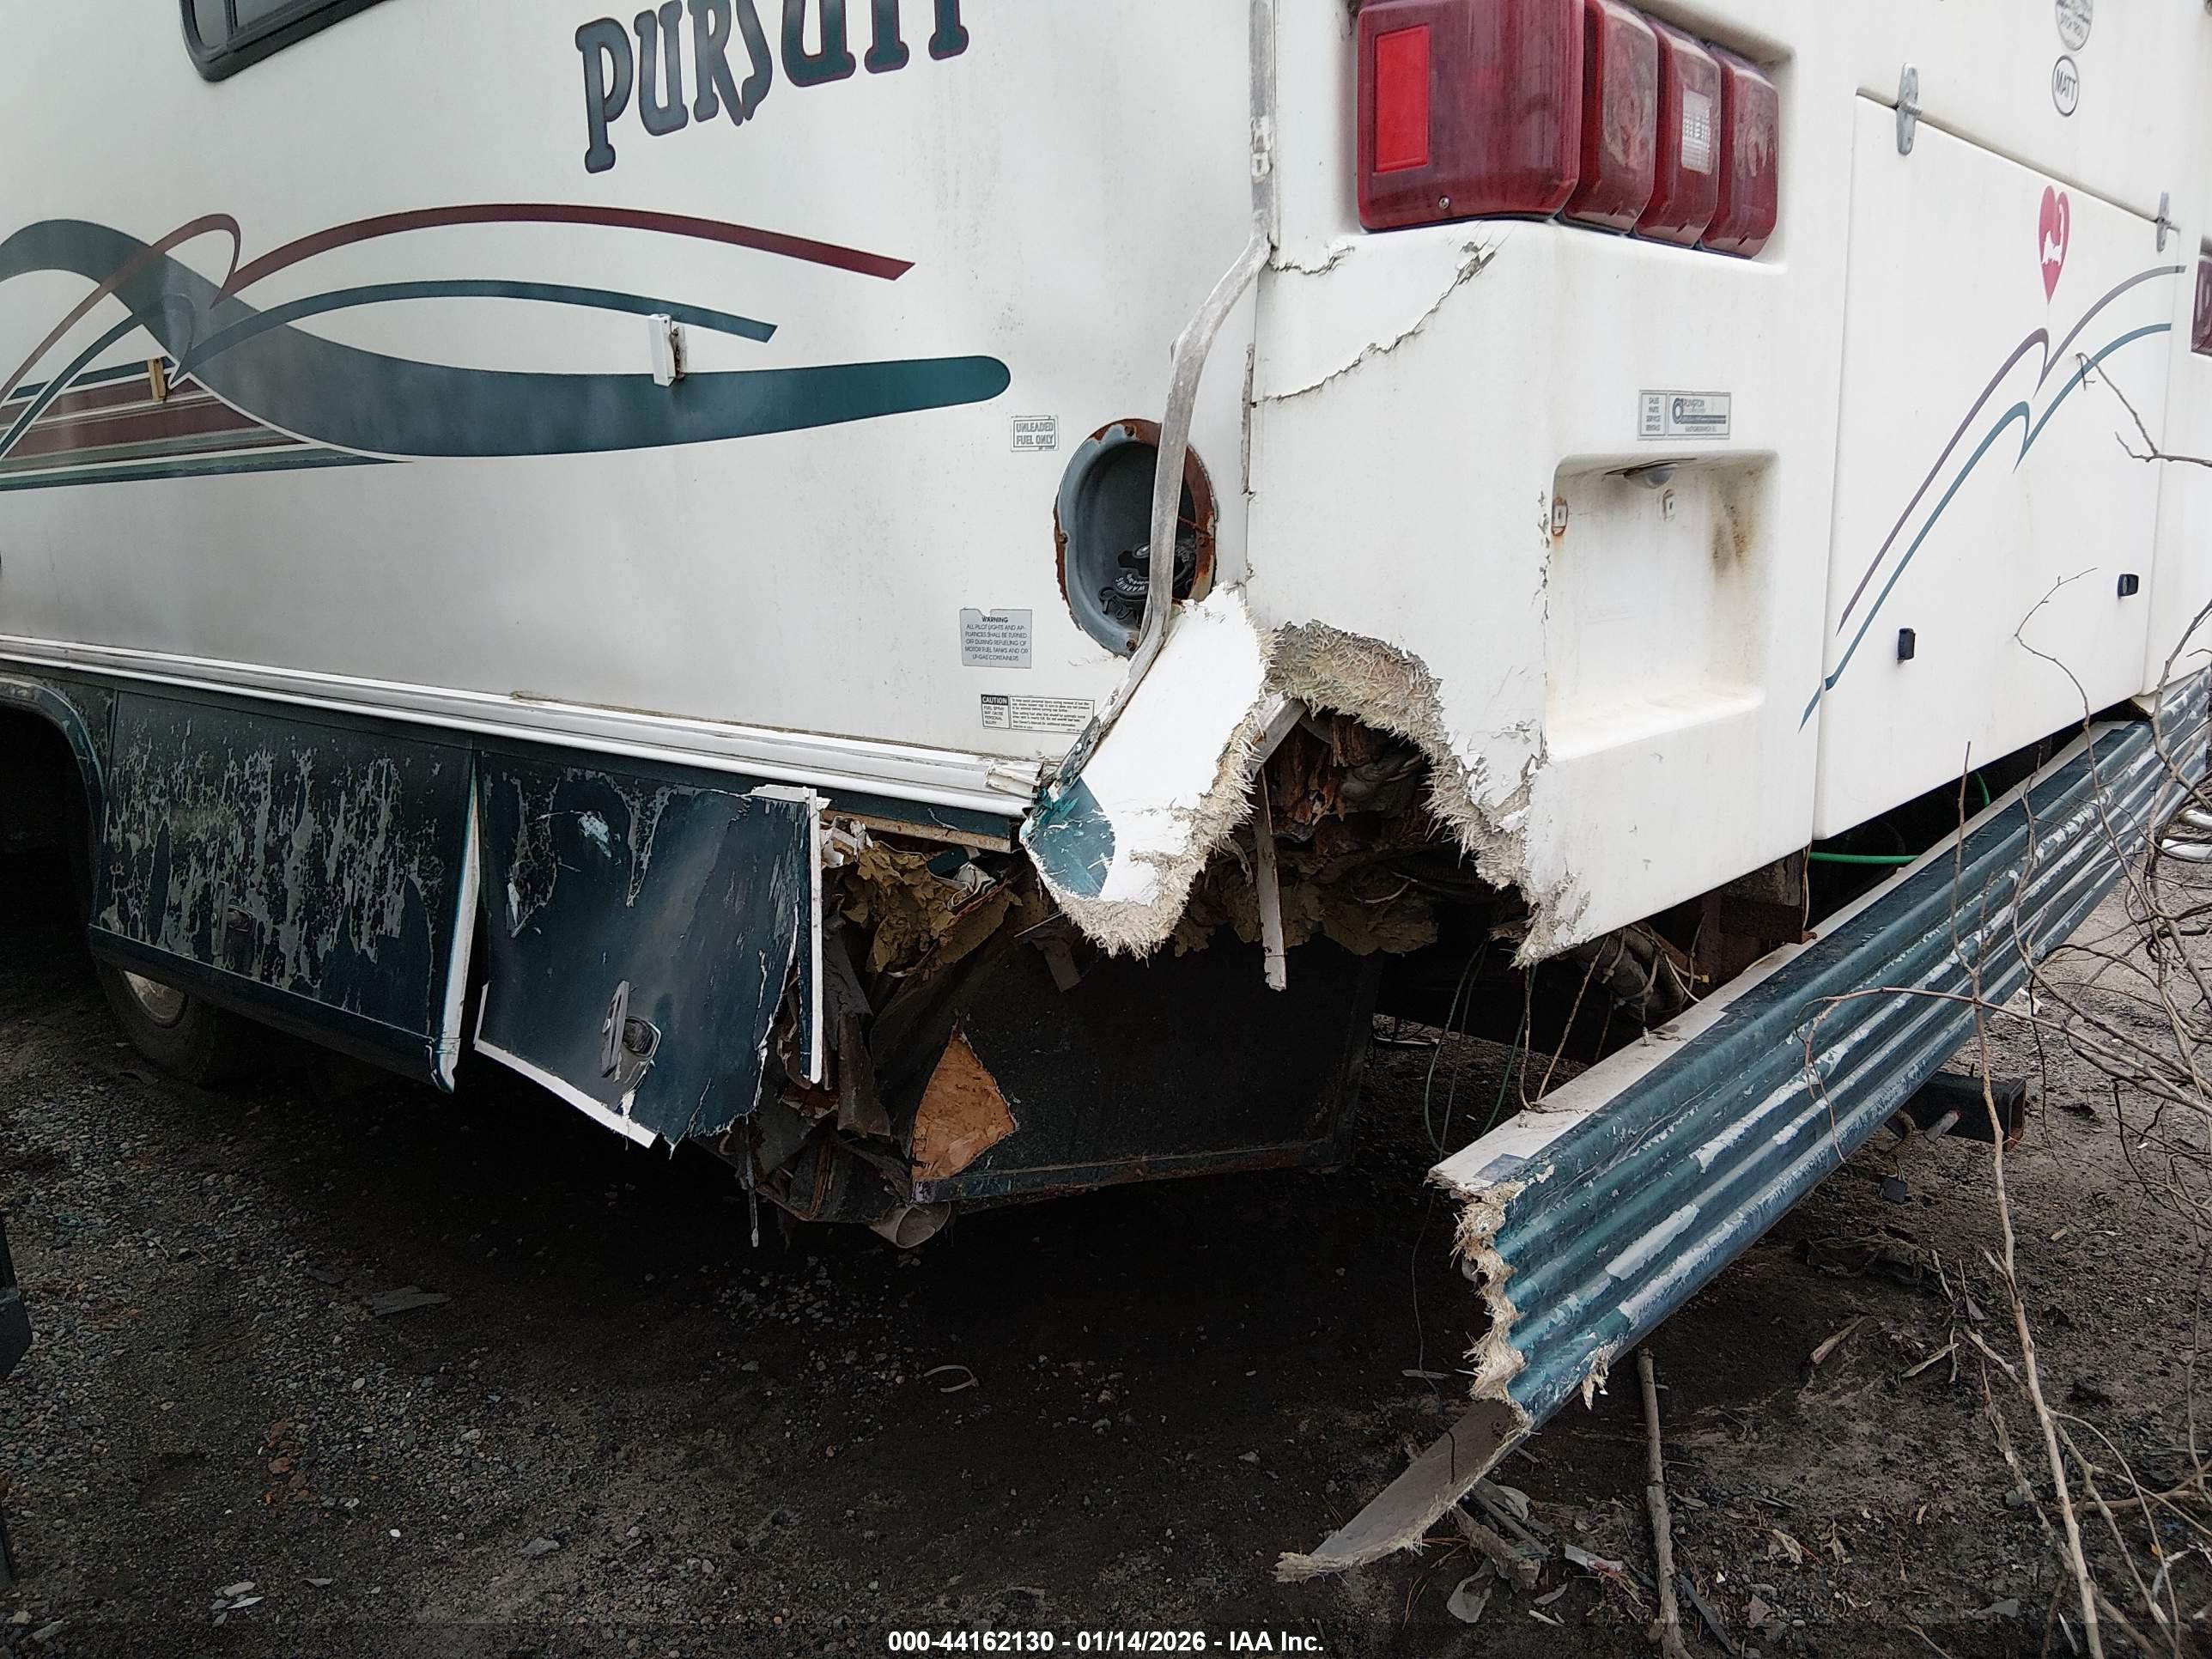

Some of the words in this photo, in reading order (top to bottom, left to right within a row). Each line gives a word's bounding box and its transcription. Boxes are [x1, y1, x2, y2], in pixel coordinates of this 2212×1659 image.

[2055, 68, 2076, 101] MATT
[1016, 422, 1054, 433] UNLEADED
[1016, 434, 1034, 445] FUEL
[1036, 434, 1054, 445] ONLY
